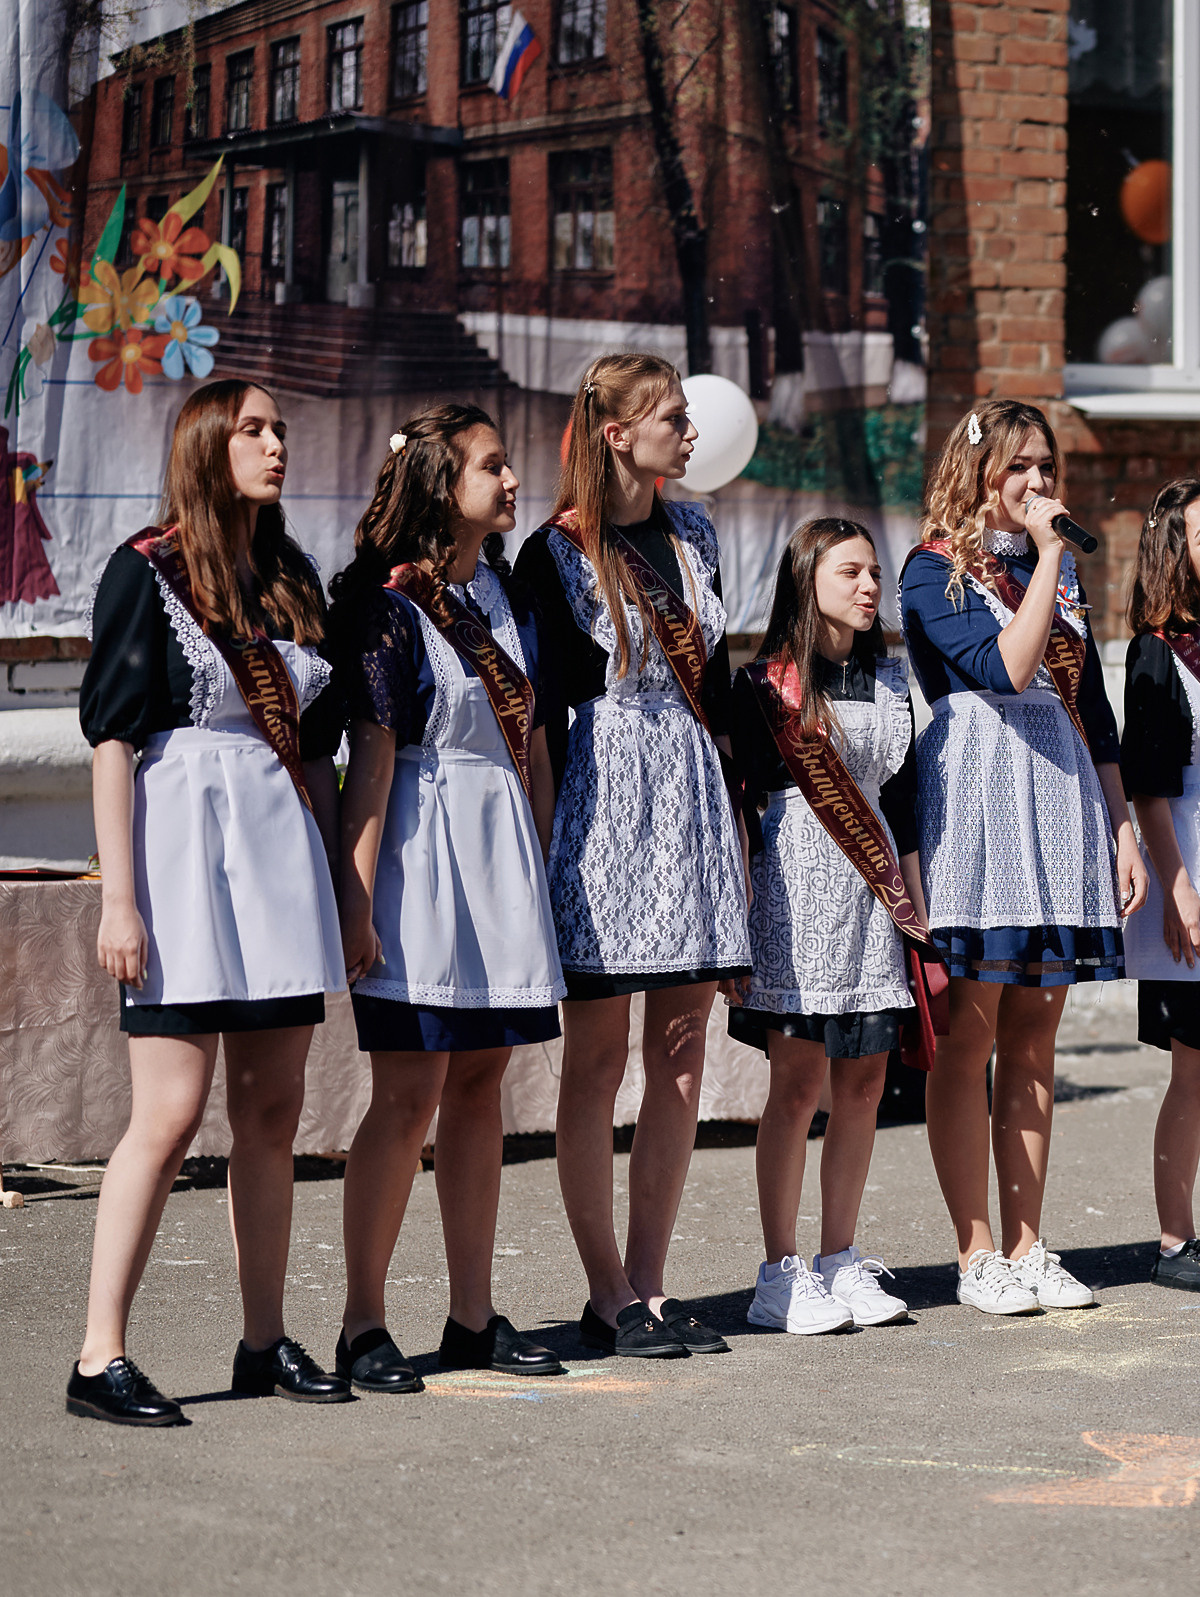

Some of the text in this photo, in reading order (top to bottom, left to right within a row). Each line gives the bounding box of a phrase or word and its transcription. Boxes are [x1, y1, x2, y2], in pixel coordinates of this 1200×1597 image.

[784, 718, 889, 873] Выпускник
[839, 835, 877, 880] 11 класс
